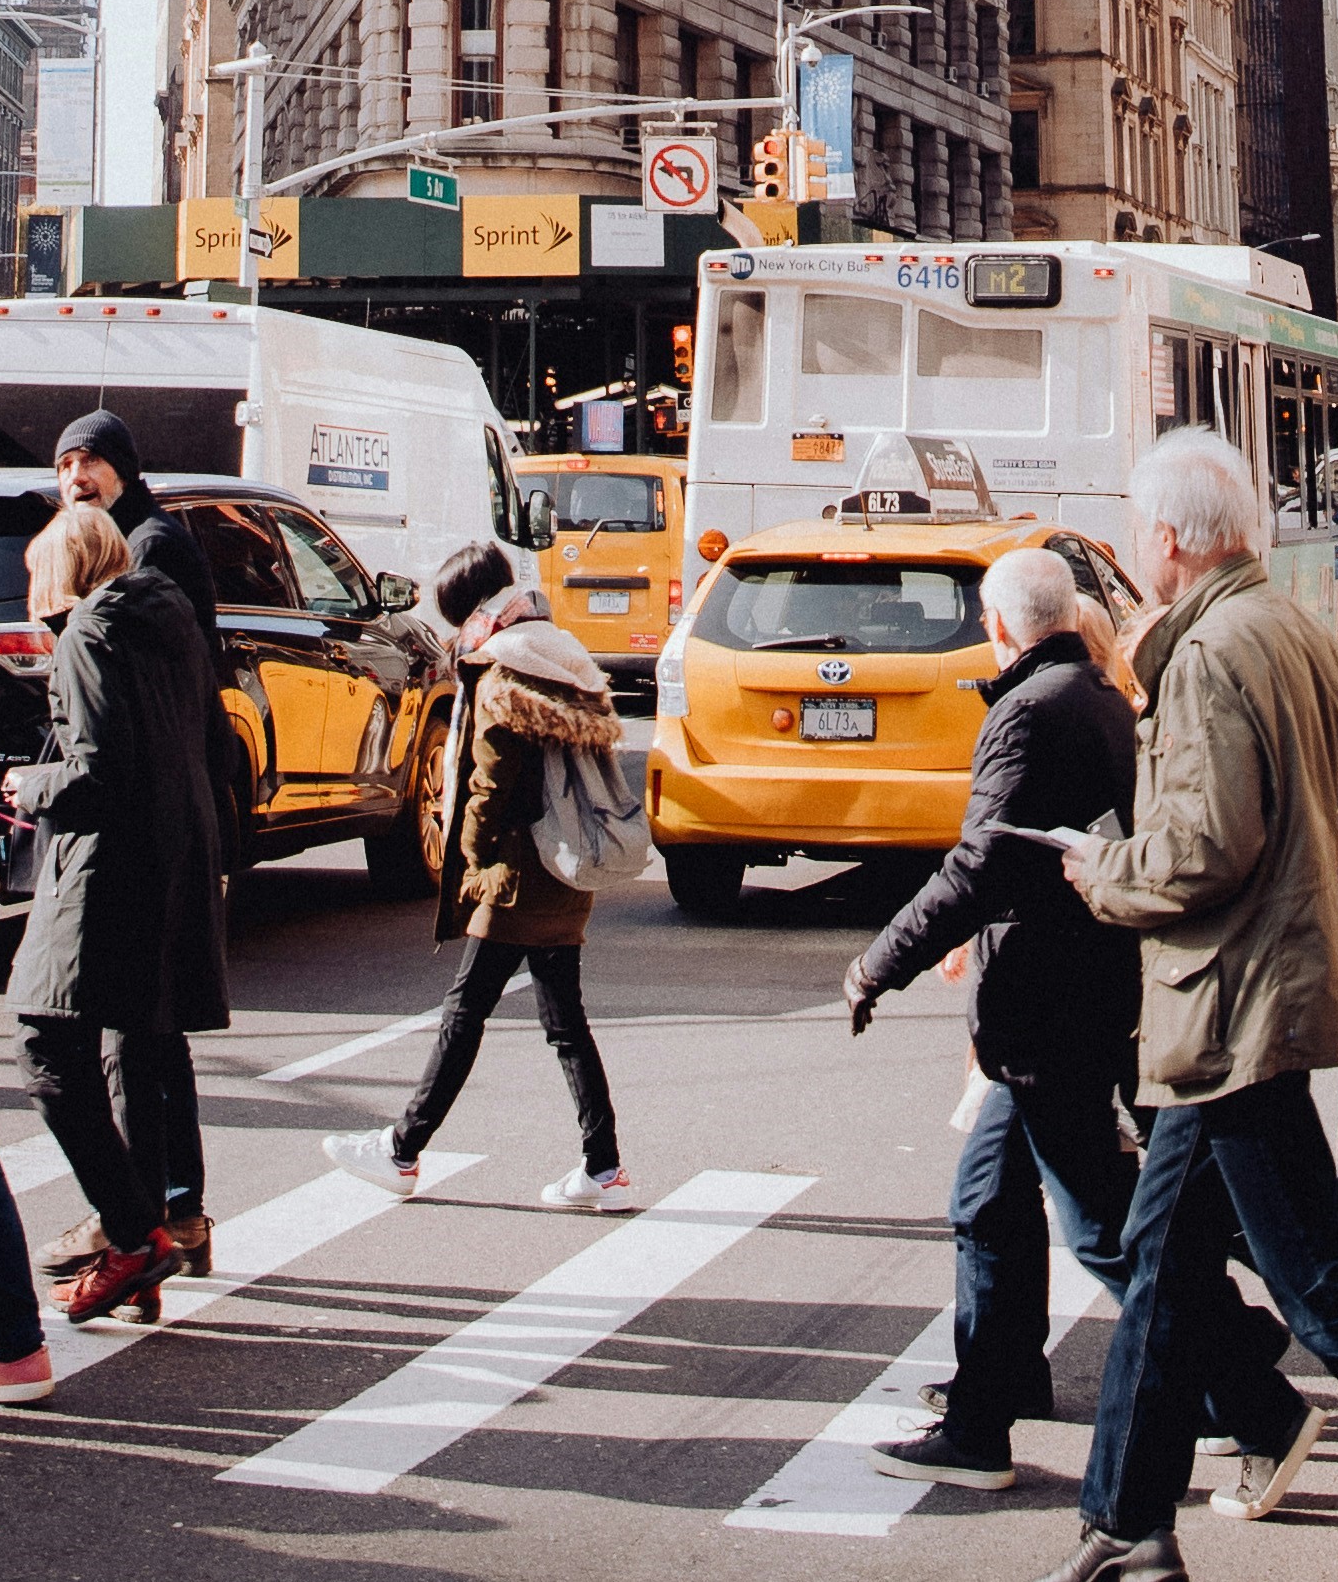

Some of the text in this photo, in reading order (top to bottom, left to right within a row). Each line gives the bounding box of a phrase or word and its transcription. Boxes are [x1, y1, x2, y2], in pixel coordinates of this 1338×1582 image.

[426, 176, 433, 197] 5
[195, 227, 241, 253] Spri
[474, 224, 540, 251] Sprint
[730, 254, 870, 275] MTA New York City Bus
[897, 265, 960, 288] 6416
[989, 263, 1026, 293] M2
[310, 423, 390, 469] ATLANTECH
[868, 491, 900, 513] 6L73
[818, 711, 859, 732] 6L73A
